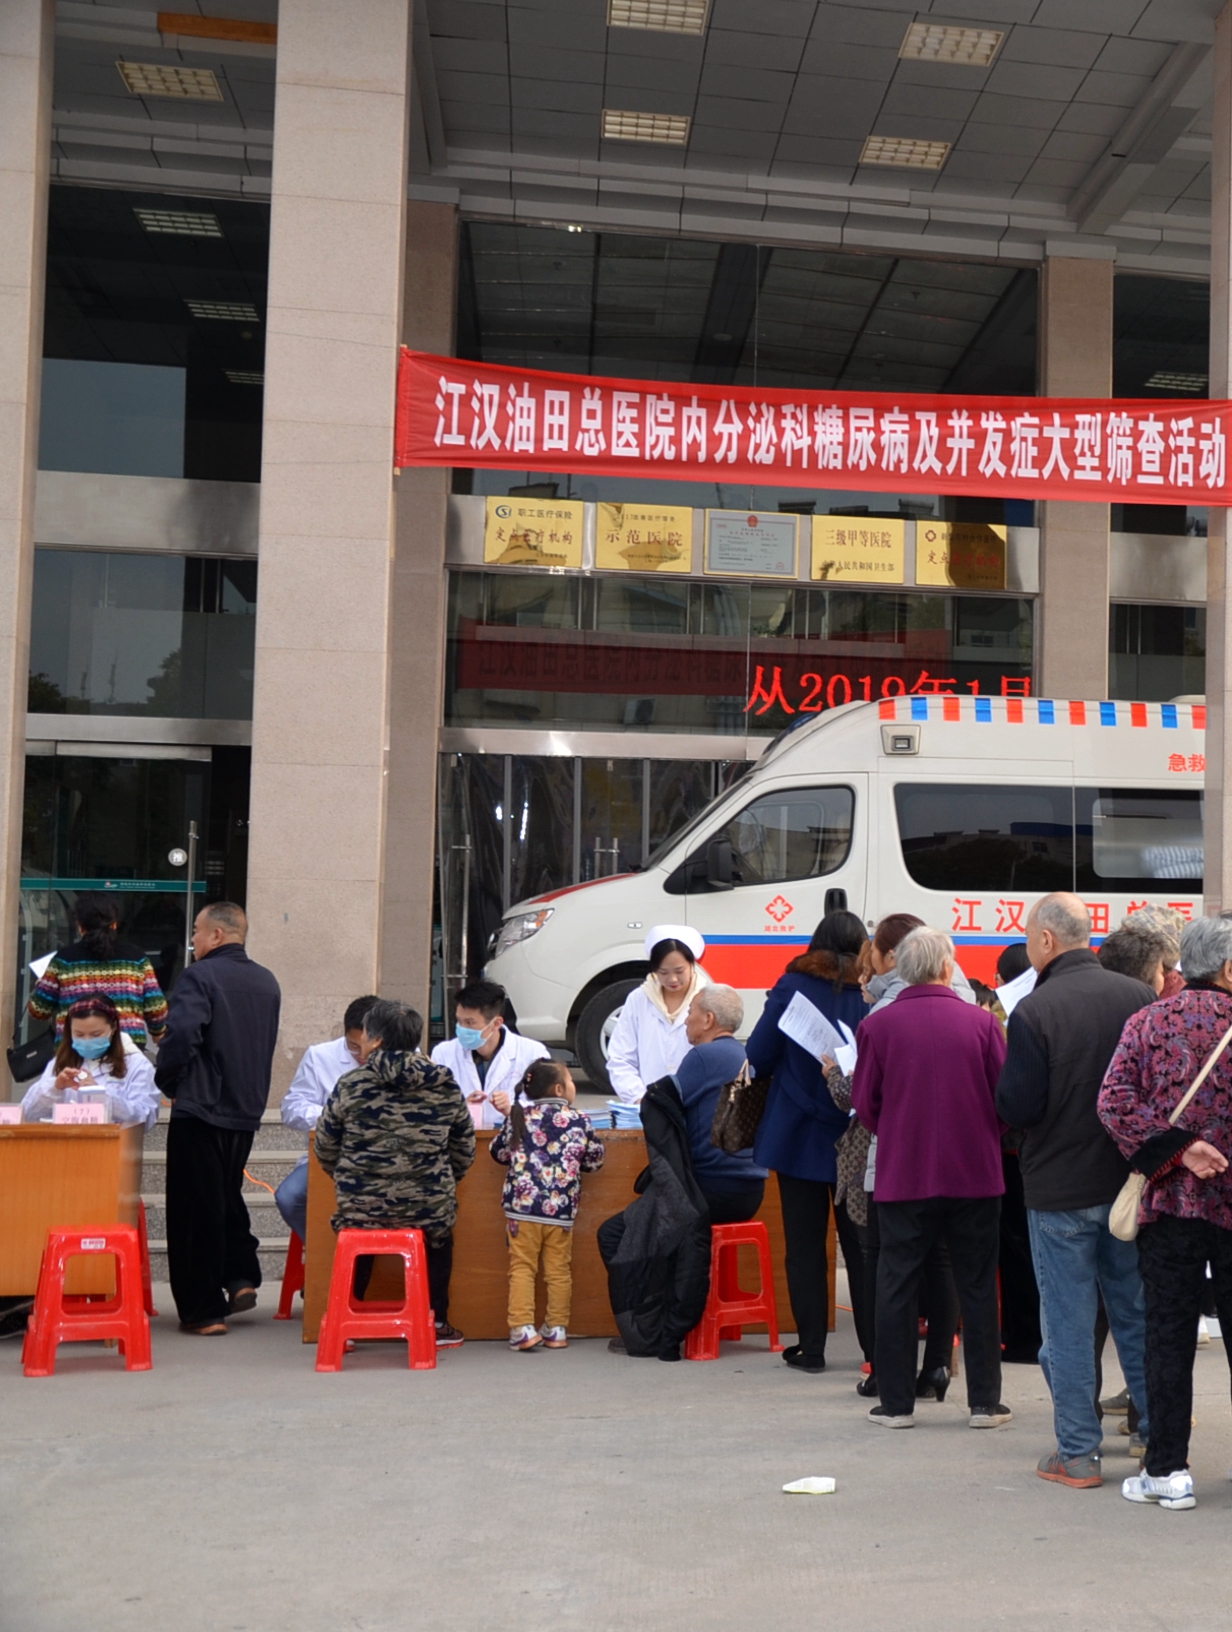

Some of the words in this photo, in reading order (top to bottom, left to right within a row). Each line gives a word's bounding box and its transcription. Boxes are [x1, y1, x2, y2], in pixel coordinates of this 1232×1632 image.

[435, 375, 1227, 488] 江汉油田总医院内分泌科糖尿病及并发症大型筛查活动
[517, 508, 573, 520] 职工医疗保险
[613, 513, 676, 522] 17改善医疗服务
[495, 526, 573, 545] 定点医疗机构
[606, 528, 683, 547] 示范医院
[825, 529, 892, 549] 三级甲等医院
[822, 560, 895, 572] 中华人民共和国卫生部
[1168, 753, 1207, 773] 急救
[951, 897, 1195, 934] 江汉田
